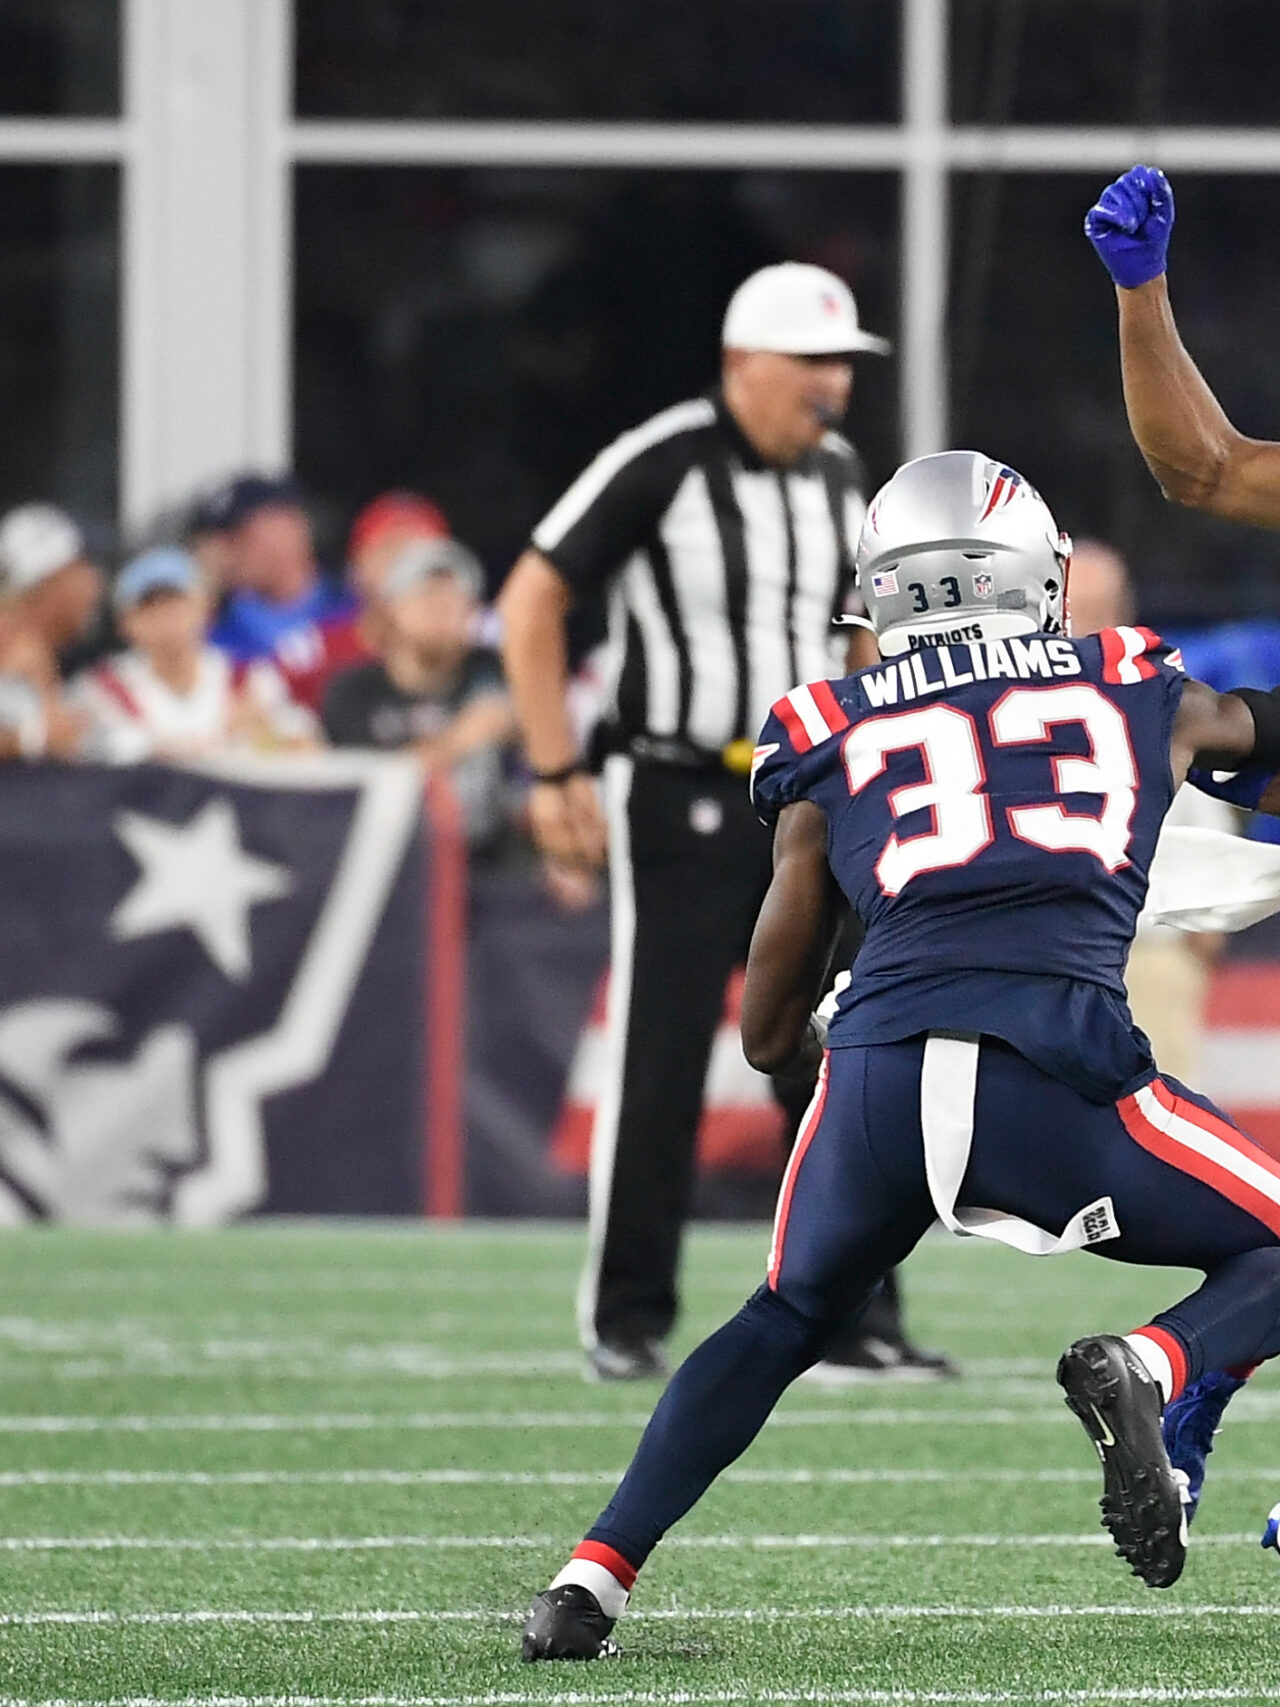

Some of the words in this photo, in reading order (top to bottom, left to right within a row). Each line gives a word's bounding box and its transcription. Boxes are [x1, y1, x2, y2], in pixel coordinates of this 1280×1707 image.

[907, 576, 962, 613] 33
[908, 623, 984, 650] PATRIOTS
[861, 638, 1082, 708] WILLIAMS
[840, 681, 1140, 897] 33
